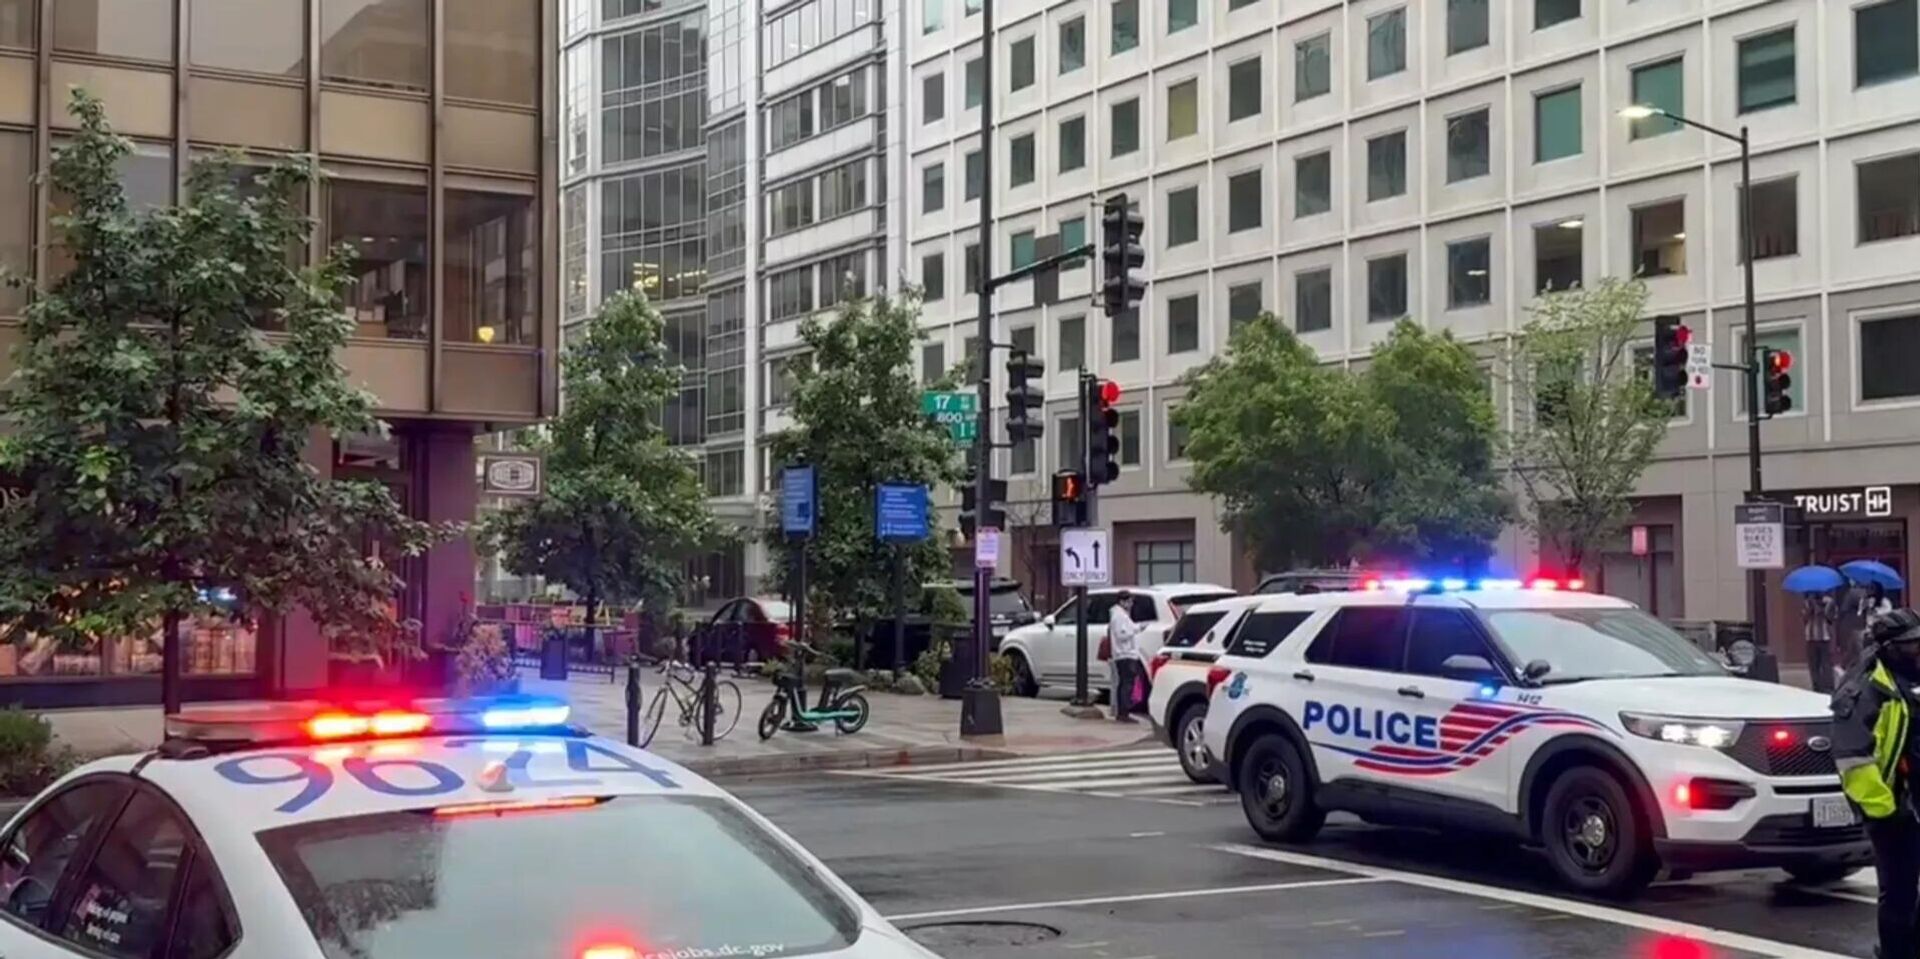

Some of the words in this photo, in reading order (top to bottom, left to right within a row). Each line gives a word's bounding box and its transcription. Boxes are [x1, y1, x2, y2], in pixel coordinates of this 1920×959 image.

[934, 395, 951, 410] 17
[937, 412, 962, 423] 800
[1794, 493, 1861, 513] TRUIST
[1303, 701, 1438, 748] POLICE
[213, 738, 682, 813] 9624
